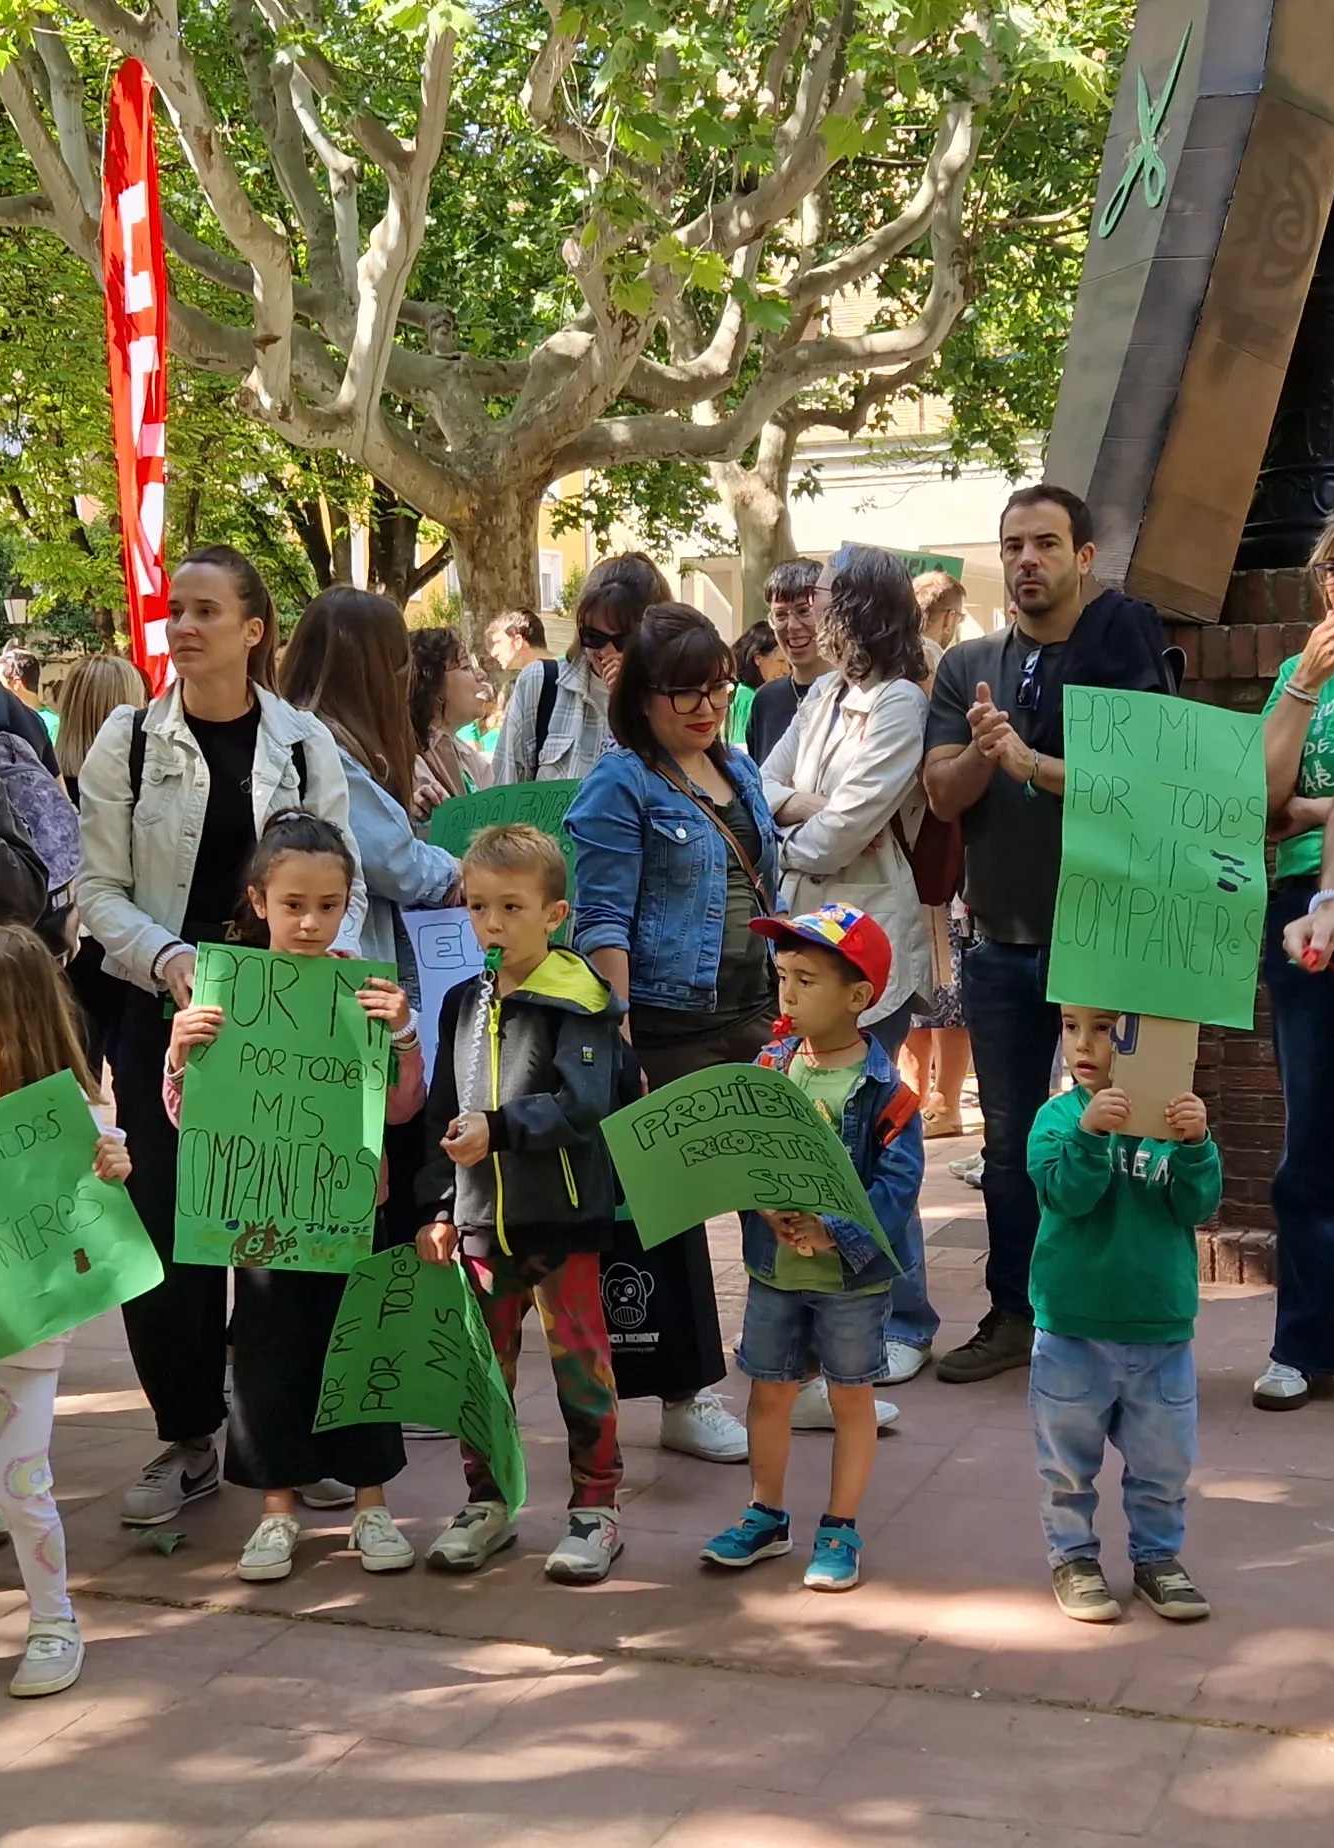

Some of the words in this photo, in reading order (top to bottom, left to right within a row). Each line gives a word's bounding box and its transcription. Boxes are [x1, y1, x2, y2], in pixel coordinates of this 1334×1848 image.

[1069, 690, 1134, 757] POR
[1156, 704, 1198, 772] MI
[1231, 724, 1258, 779] Y
[1304, 740, 1330, 757] DE
[1073, 767, 1133, 819] POR
[1161, 782, 1264, 846] TOD@S
[1128, 832, 1210, 894] MIS
[1057, 873, 1260, 982] COMPAÑER@S
[200, 949, 299, 1030] POR
[239, 1042, 286, 1075] POR
[293, 1053, 386, 1091] TOD@S
[252, 1089, 324, 1138] MIS
[178, 1127, 379, 1225] COMPAÑER@S
[350, 1271, 376, 1291] Y
[331, 1317, 362, 1354] MI
[425, 1307, 464, 1381] MIS
[316, 1373, 347, 1428] POR
[360, 1350, 407, 1412] POR
